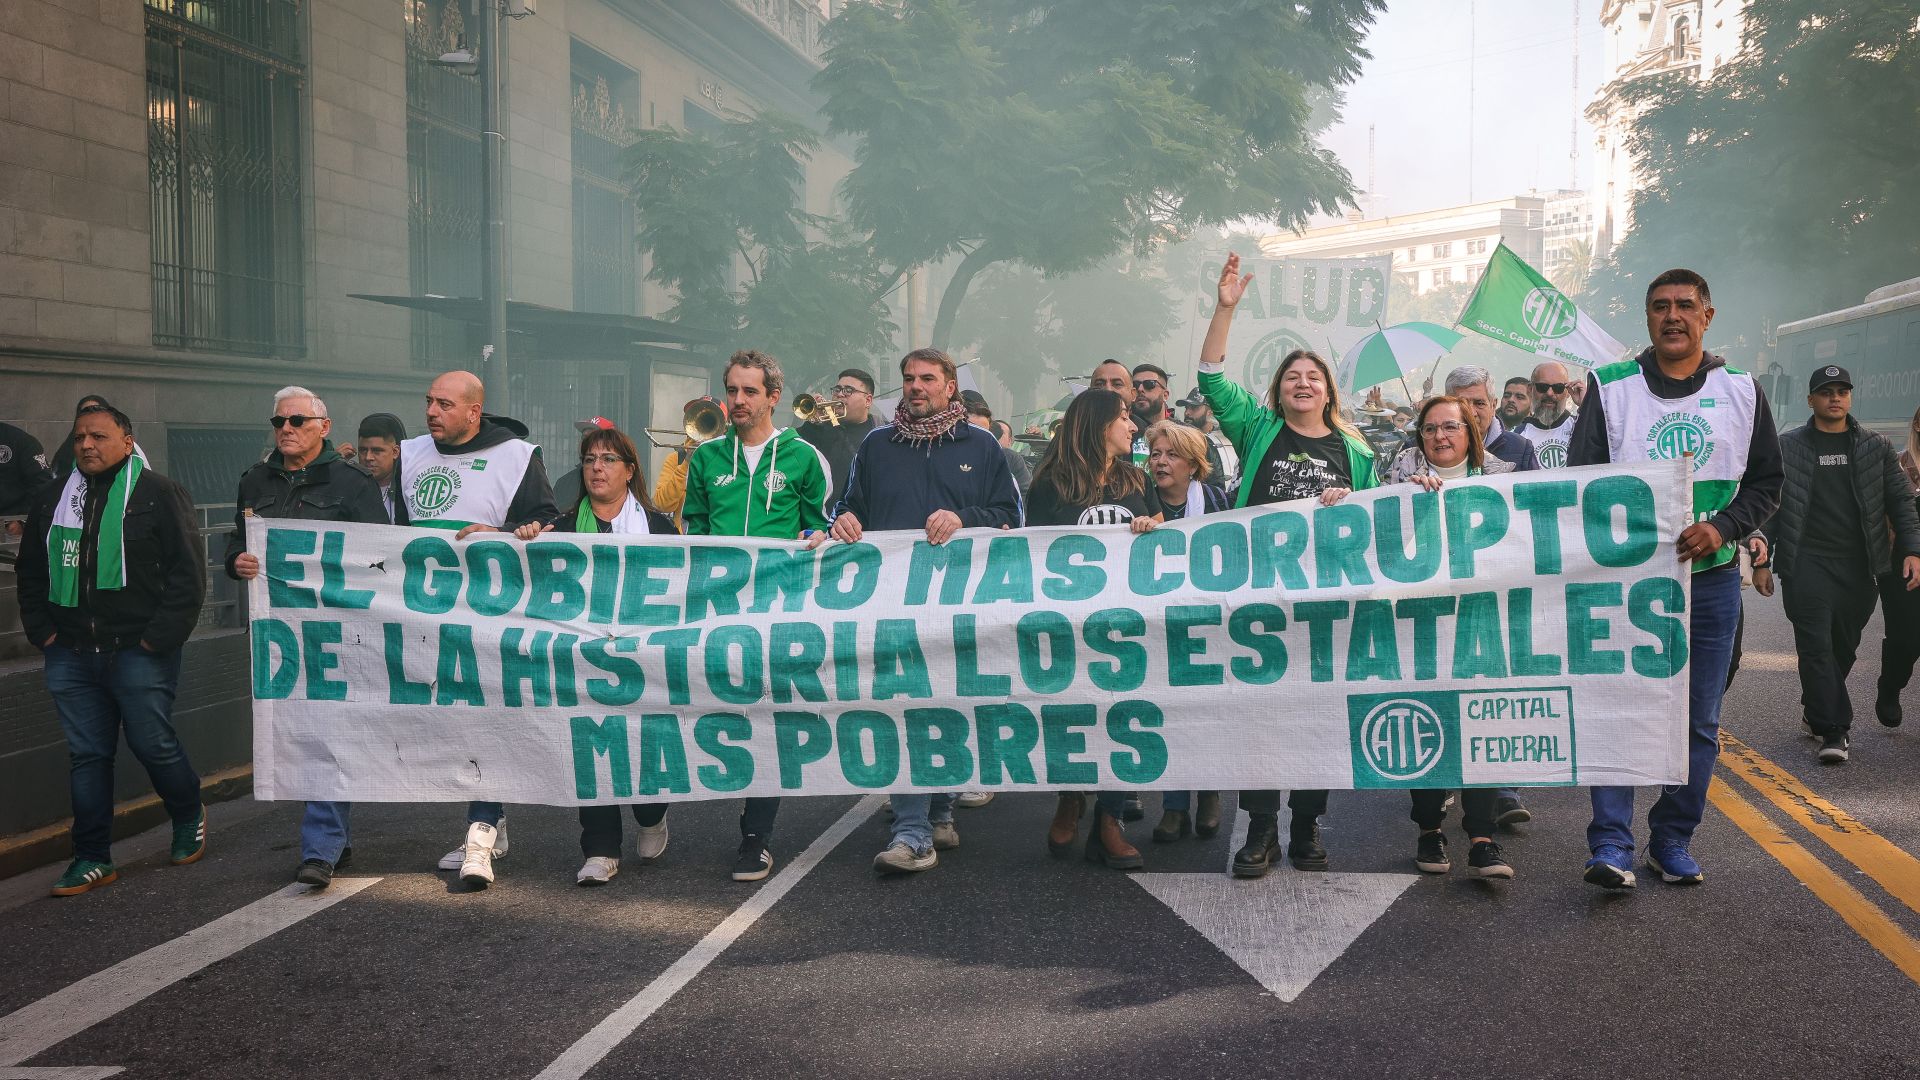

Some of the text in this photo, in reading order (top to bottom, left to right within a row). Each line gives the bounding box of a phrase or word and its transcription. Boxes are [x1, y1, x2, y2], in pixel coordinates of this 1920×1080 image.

[1198, 261, 1385, 327] SALUD
[1476, 319, 1595, 368] Secc. Capital Federal
[1647, 412, 1713, 441] FORTALECER EL ESTADO
[1662, 427, 1699, 459] ATE
[1542, 448, 1568, 468] ATE
[418, 477, 449, 507] ATE
[266, 475, 1659, 625] EL GOBIERNO MAS CORRUPTO
[252, 576, 1690, 708] DE LA HISTORIA LOS ESTATALES
[1467, 697, 1561, 721] CAPITAL
[569, 700, 1169, 800] MAS POBRES
[1371, 708, 1435, 769] ATE
[1469, 734, 1567, 763] FEDERAL
